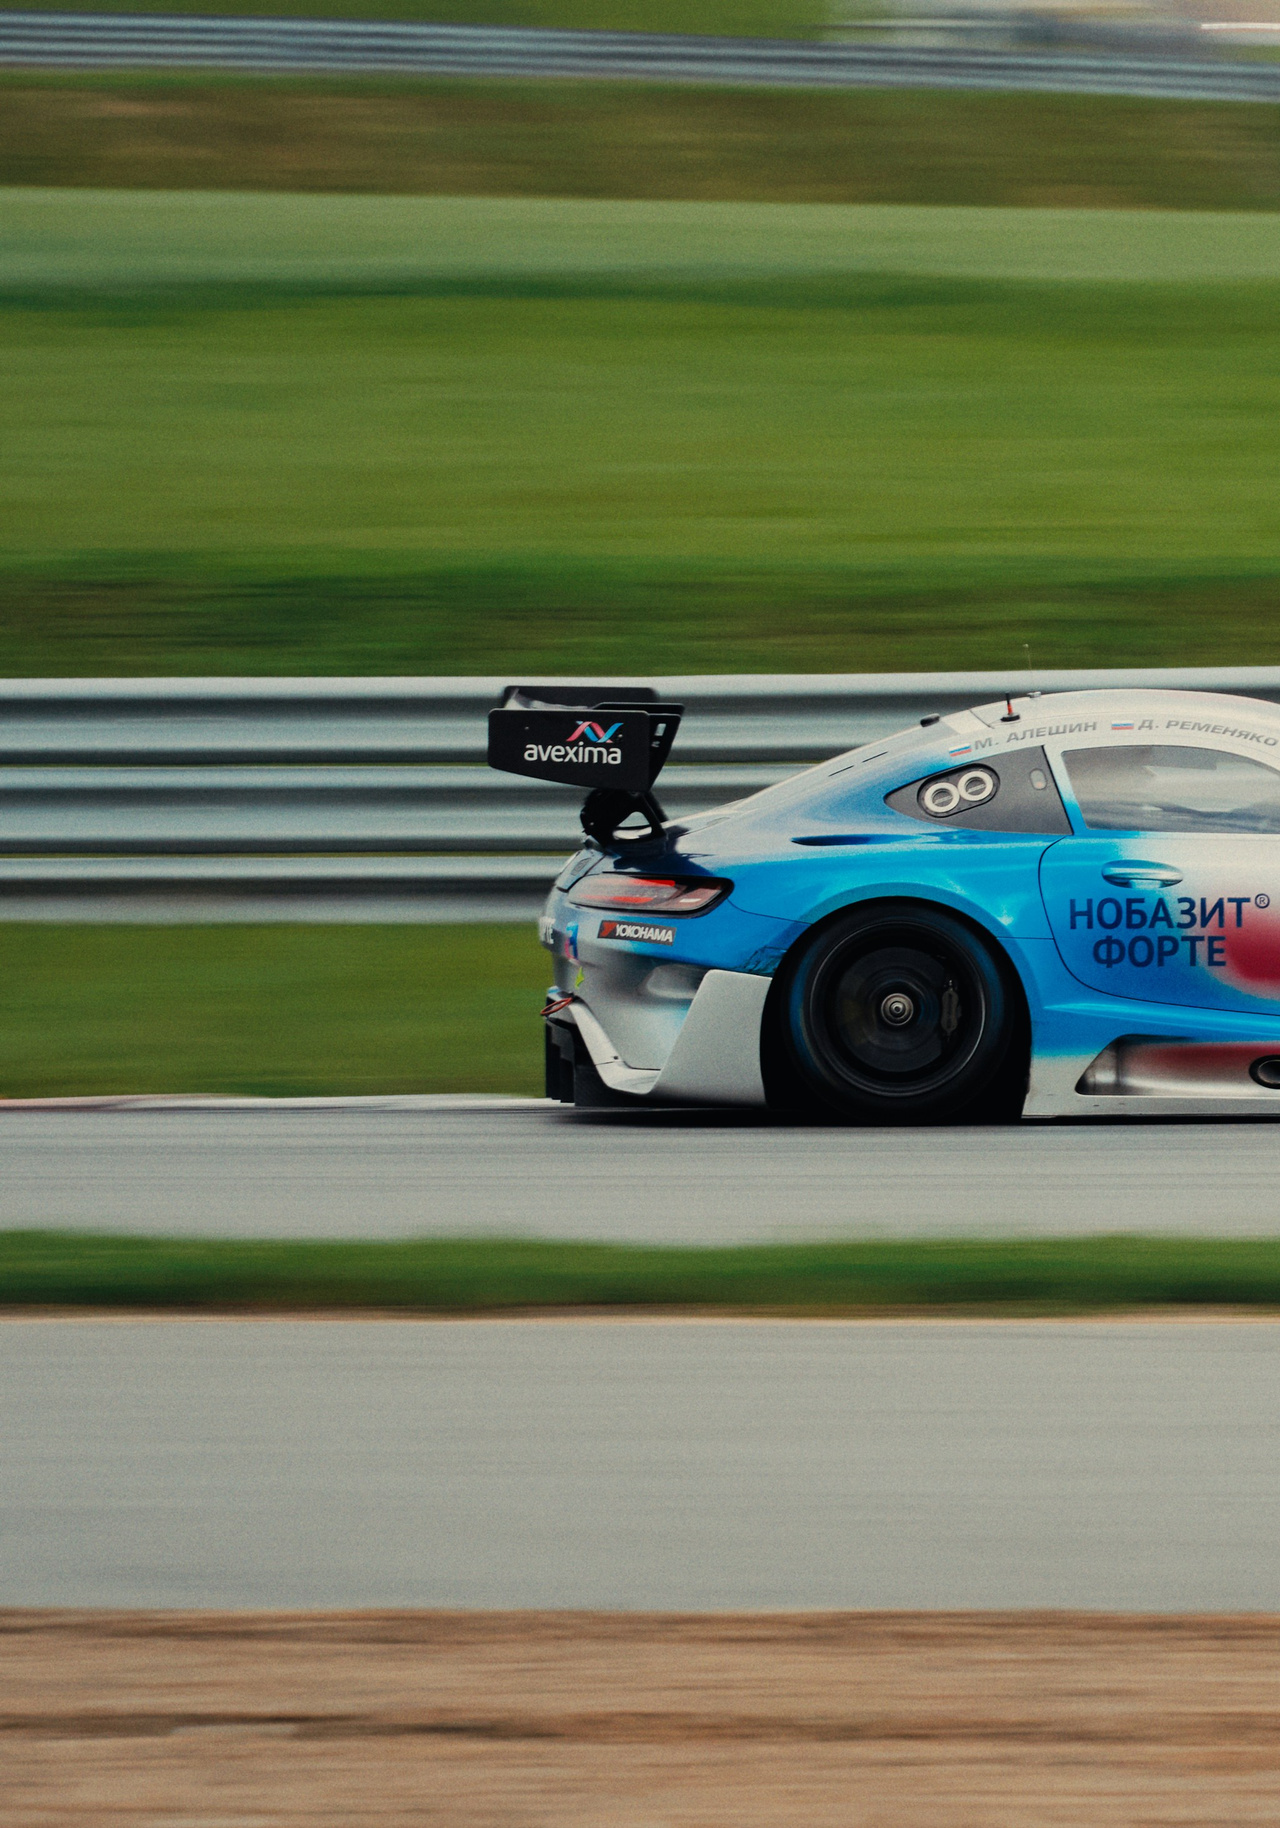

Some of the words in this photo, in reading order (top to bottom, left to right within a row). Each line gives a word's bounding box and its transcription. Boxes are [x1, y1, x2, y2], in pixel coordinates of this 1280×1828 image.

[973, 737, 998, 751] М.
[1006, 720, 1098, 744] АЛЕШИН
[1137, 719, 1160, 731] Д.
[1165, 719, 1280, 748] РЕМЕНЯКО
[523, 741, 622, 765] avexima
[614, 923, 674, 943] YOKOHAMA
[1092, 935, 1227, 969] ФОРТЕ
